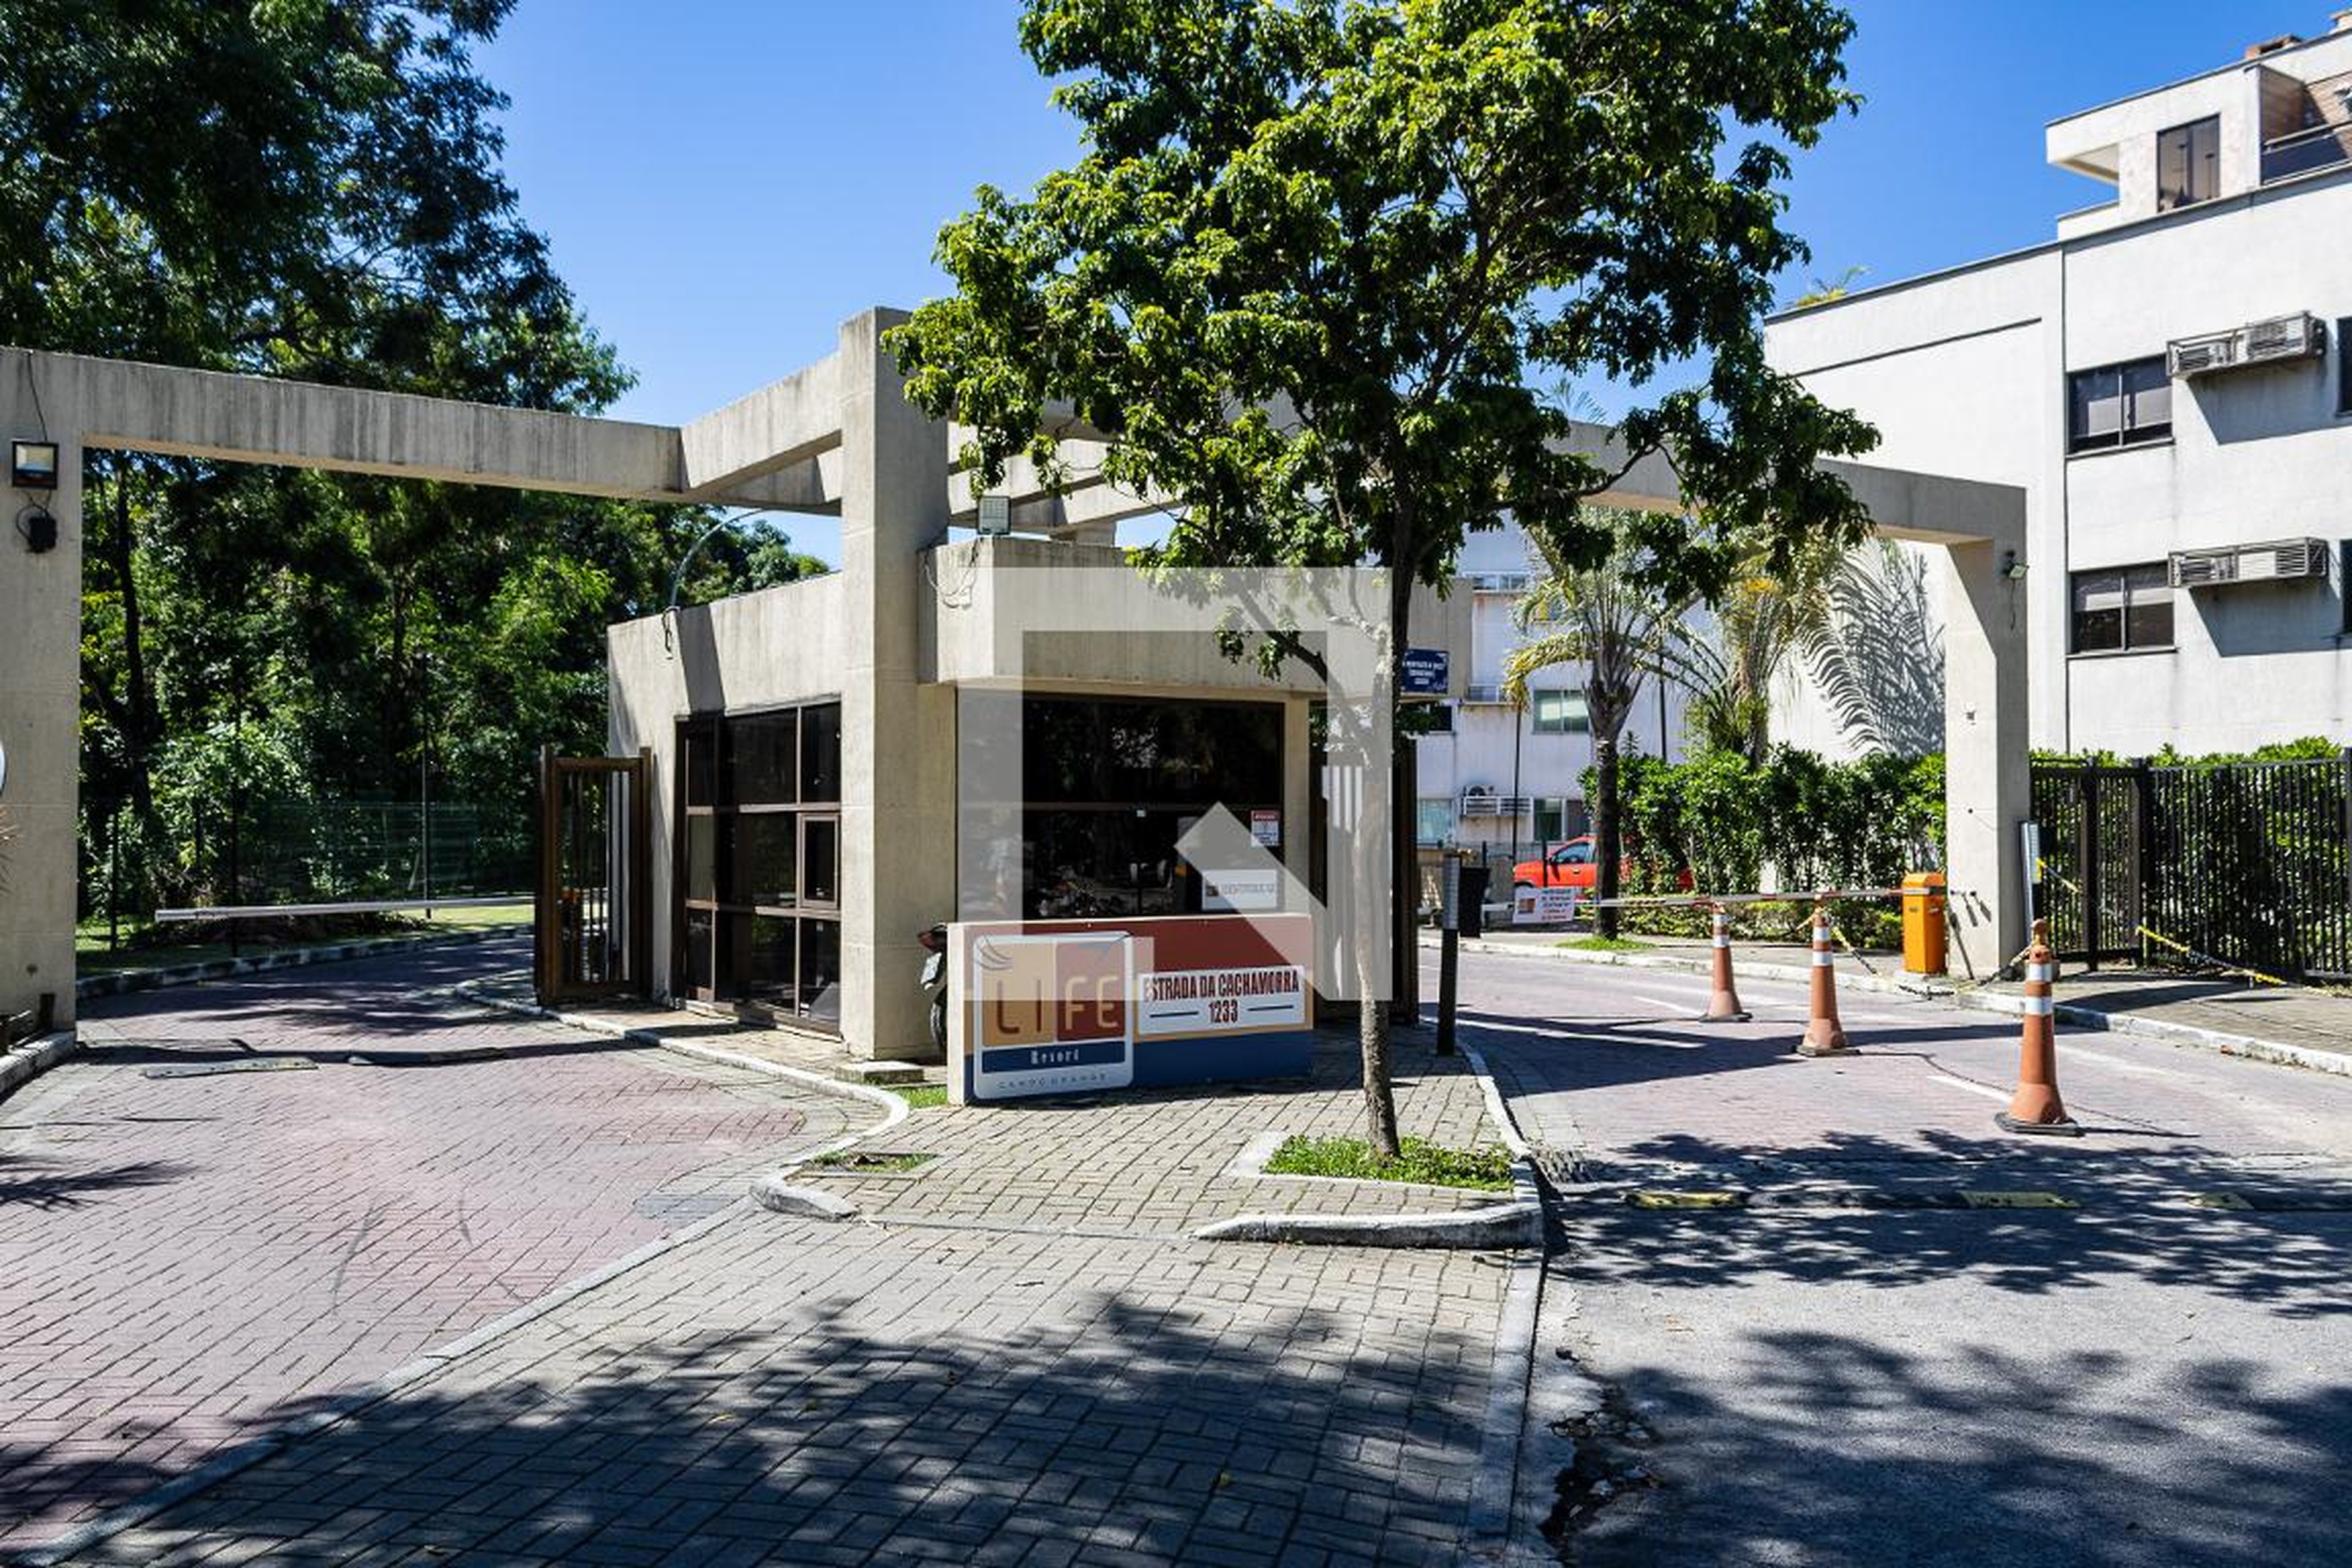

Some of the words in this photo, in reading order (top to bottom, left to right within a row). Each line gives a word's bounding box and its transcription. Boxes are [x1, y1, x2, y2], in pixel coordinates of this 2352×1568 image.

[1144, 977, 1196, 1002] ESTRADA
[1199, 975, 1216, 997] DA
[997, 975, 1119, 1034] LIFE
[1208, 999, 1238, 1023] 1233
